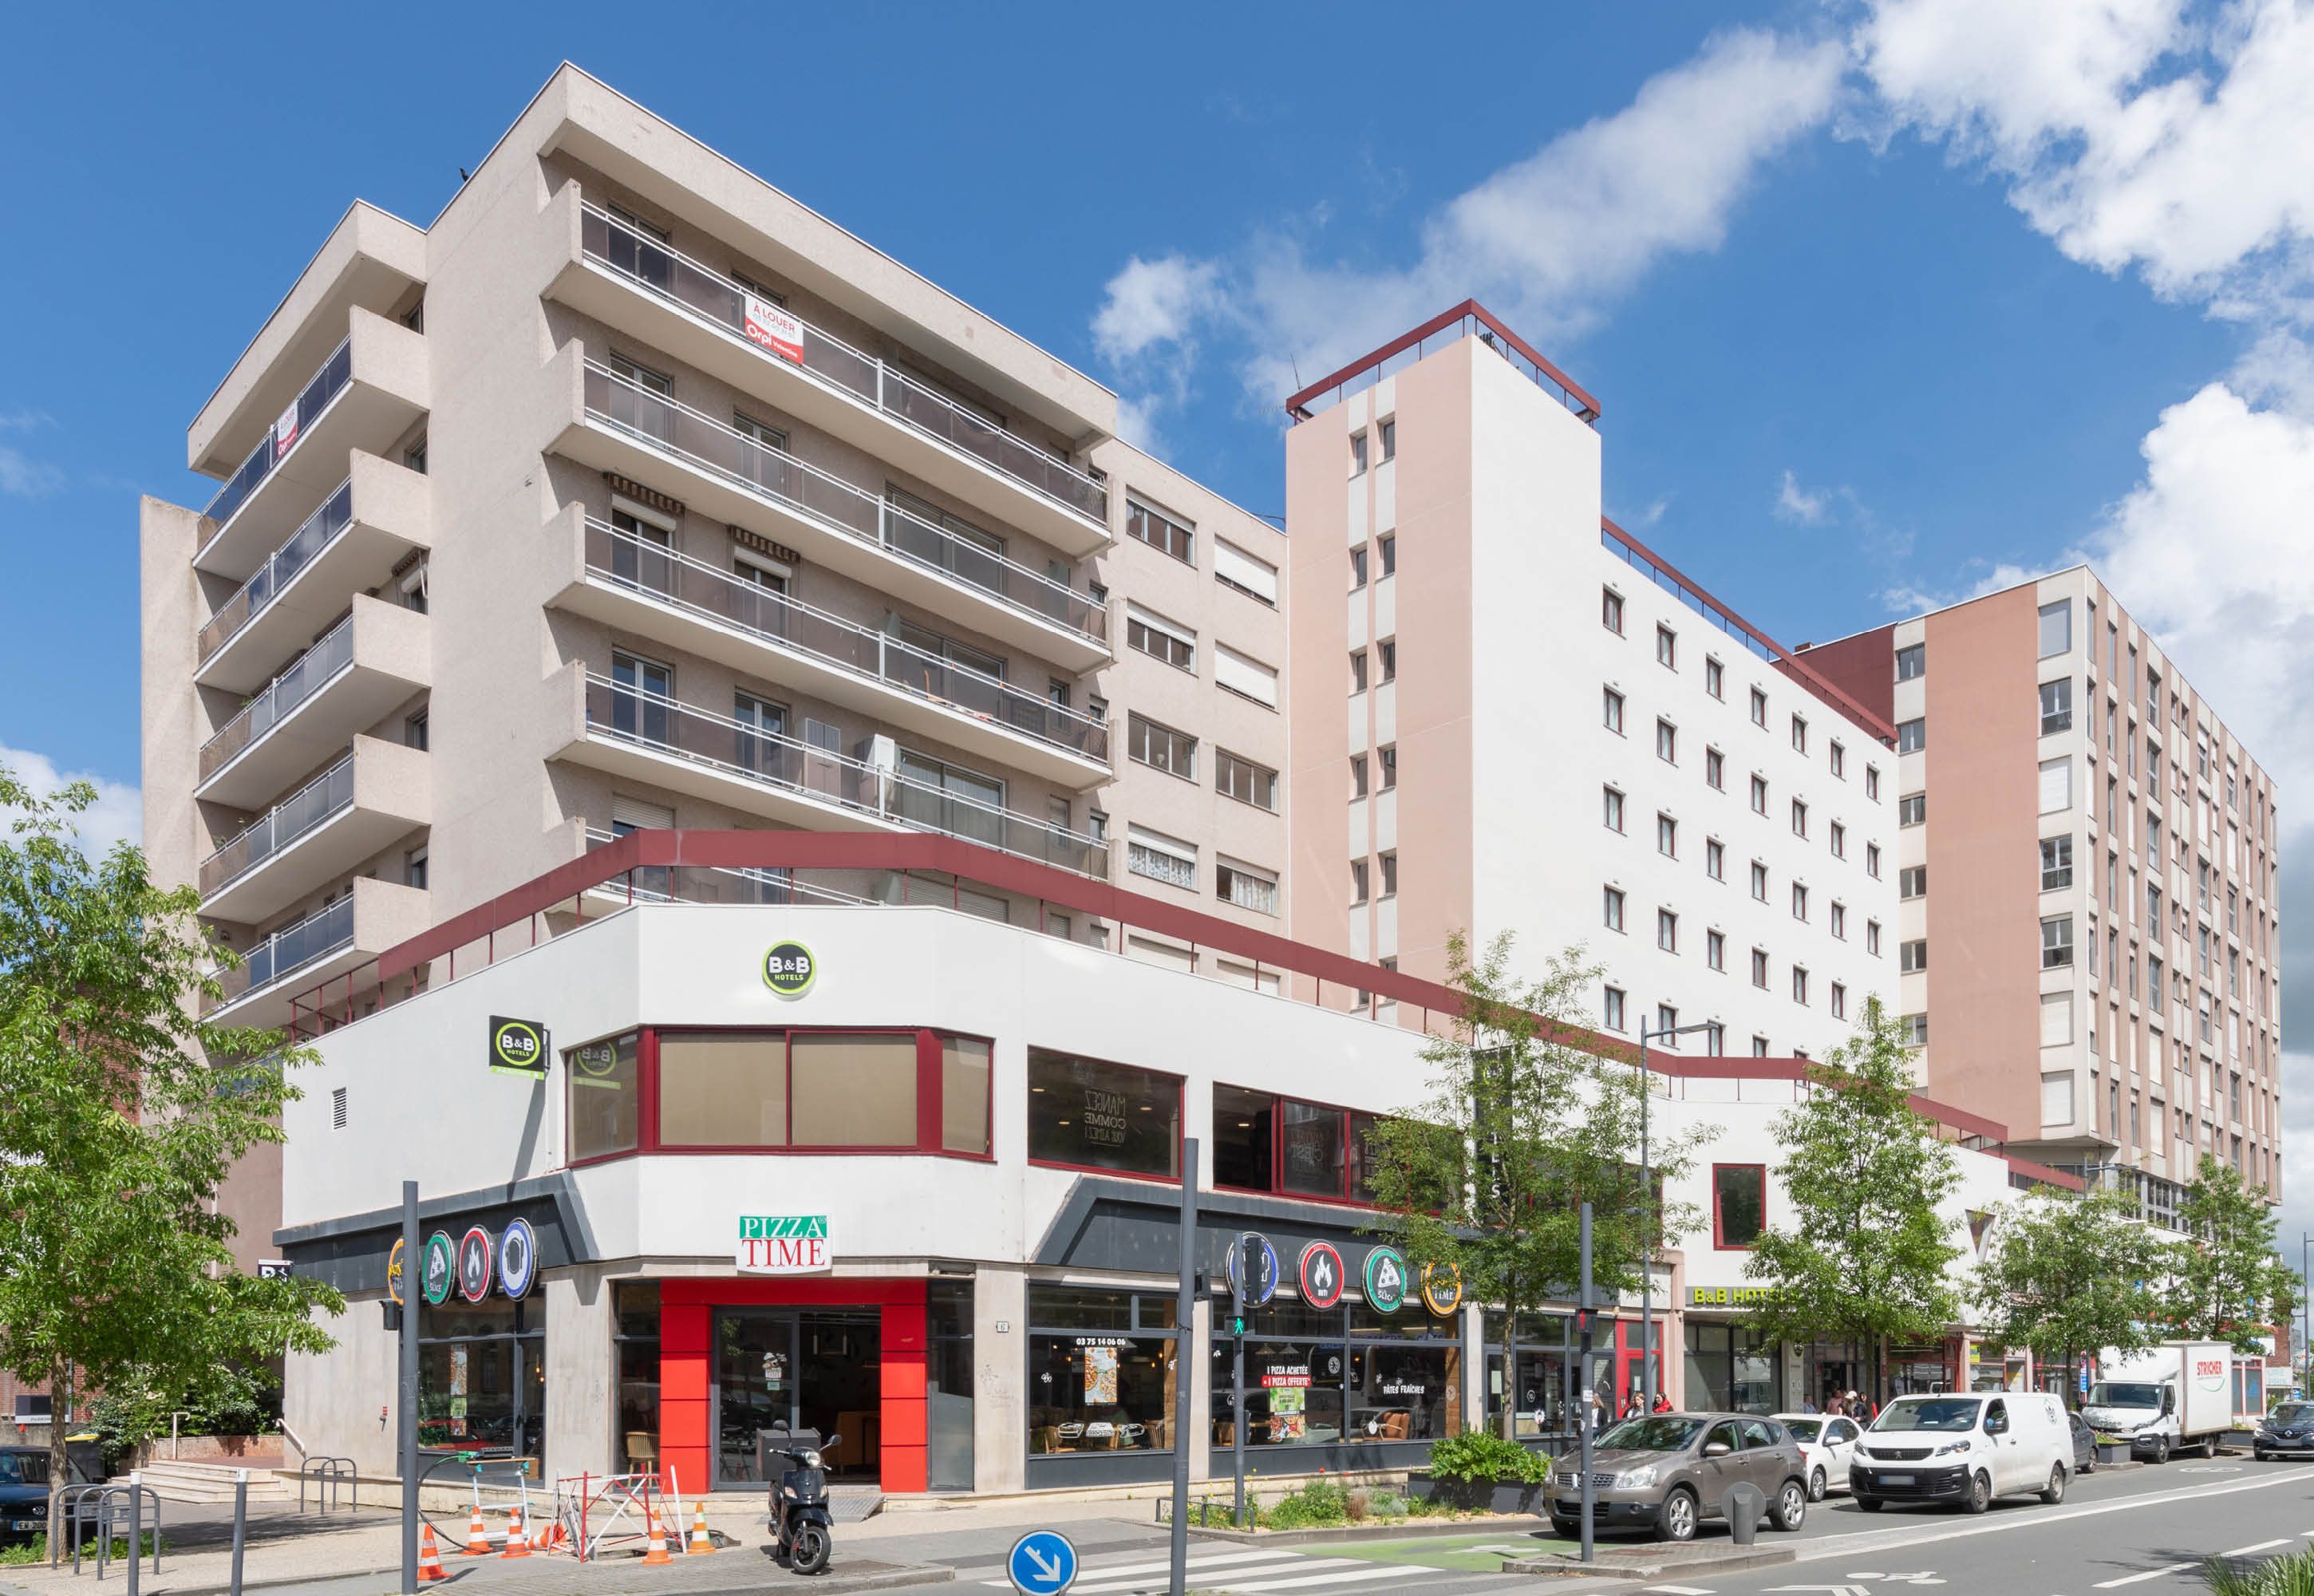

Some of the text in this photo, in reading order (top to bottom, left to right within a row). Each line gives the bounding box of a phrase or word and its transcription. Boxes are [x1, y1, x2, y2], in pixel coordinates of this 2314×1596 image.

[763, 309, 795, 333] LOUER
[747, 324, 772, 346] Orpi
[768, 957, 810, 974] B&B
[502, 1034, 535, 1052] B&B
[743, 1218, 823, 1238] PIZZA
[741, 1238, 825, 1267] TIME
[1694, 1288, 1727, 1303] B&B
[1270, 1365, 1285, 1375] PIZZA
[1286, 1364, 1309, 1375] ACHETÉE
[1272, 1377, 1286, 1386] PIZZA
[1383, 1384, 1424, 1394] PÂTES FRAÎCHES
